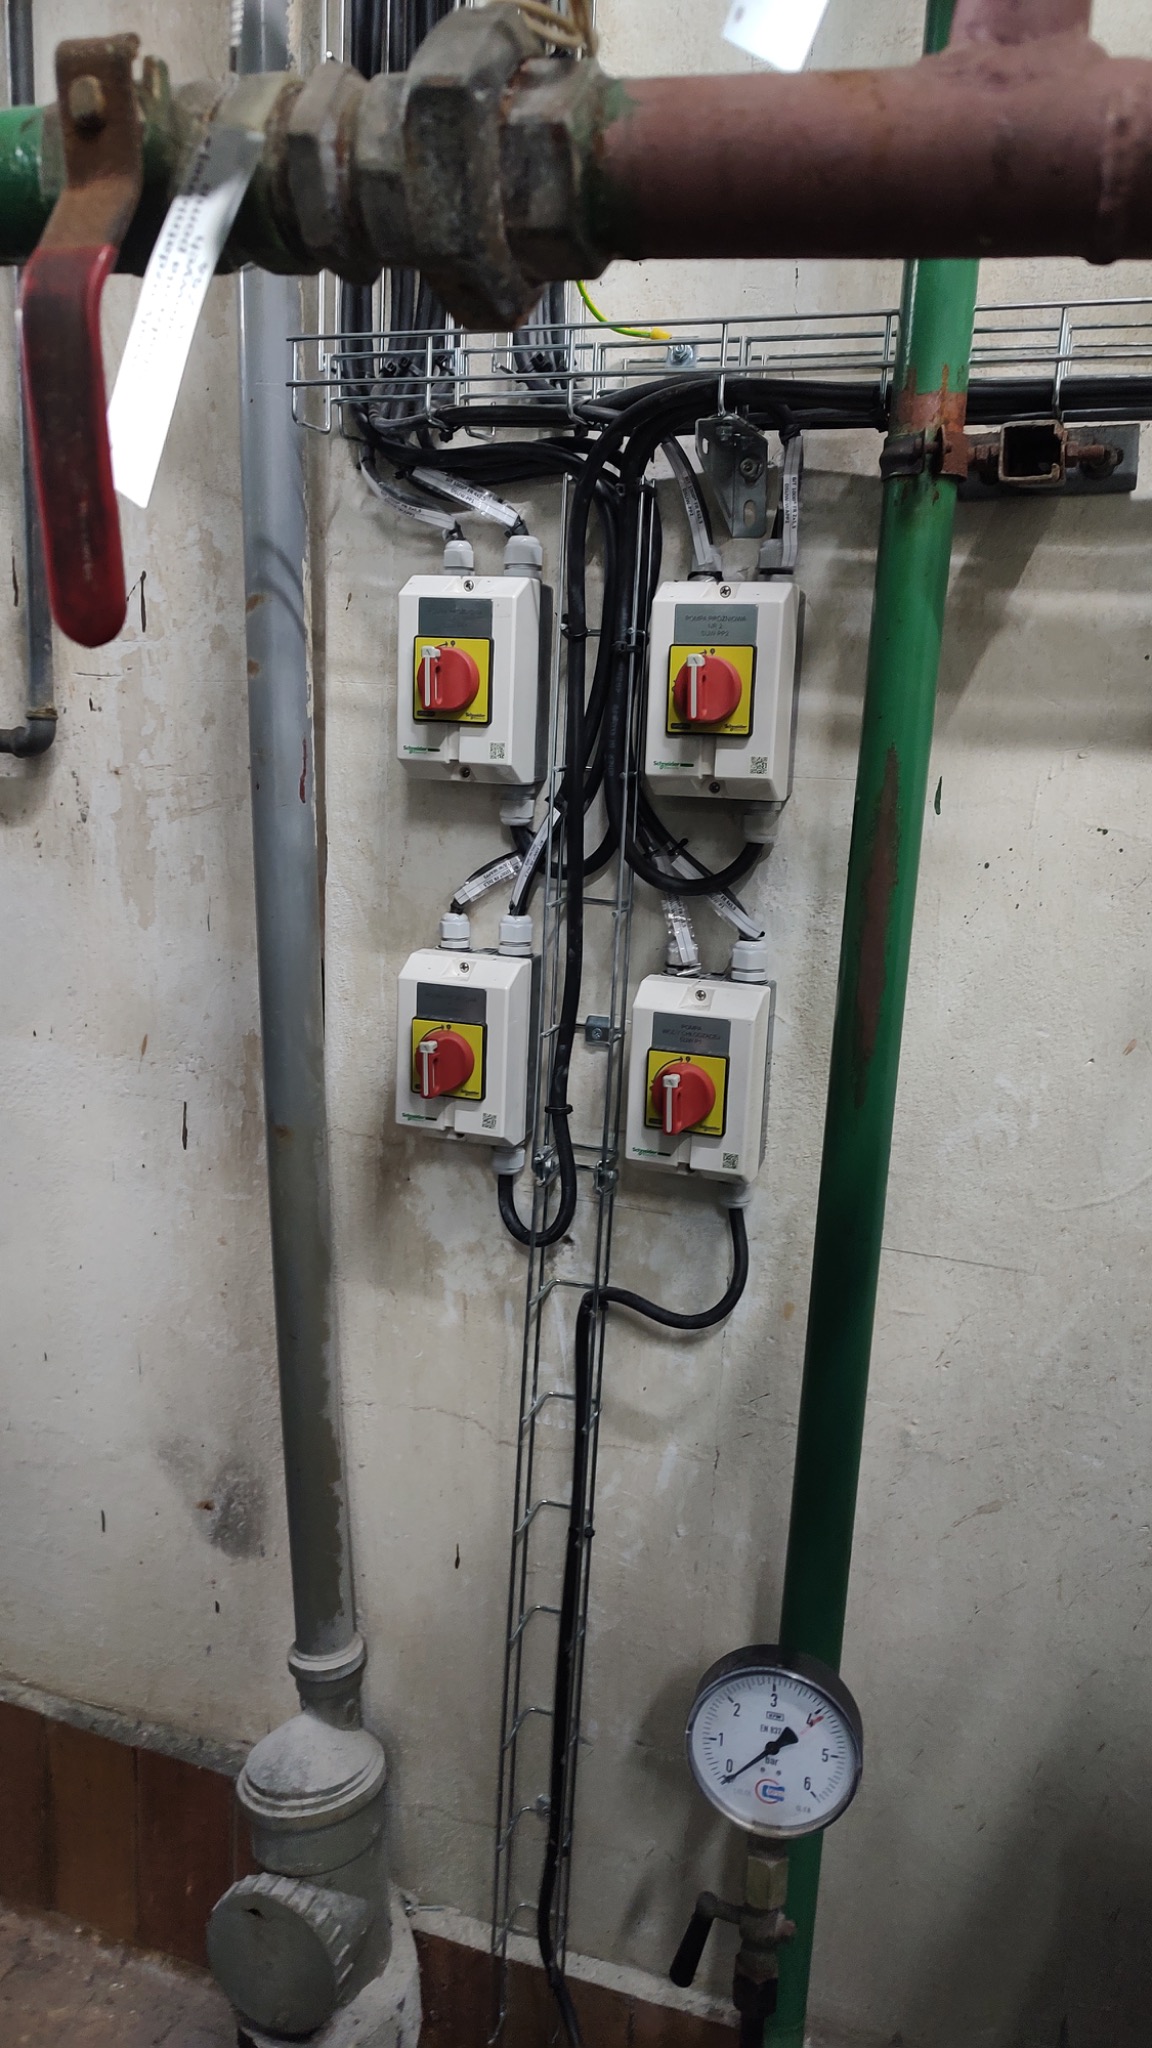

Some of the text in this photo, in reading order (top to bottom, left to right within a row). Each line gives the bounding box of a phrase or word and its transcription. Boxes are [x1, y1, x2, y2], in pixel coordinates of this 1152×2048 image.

[770, 1693, 778, 1708] 3
[733, 1702, 741, 1717] 2
[718, 1732, 724, 1746] 1
[765, 1756, 778, 1766] bar
[822, 1748, 829, 1762] 5
[726, 1758, 733, 1773] 0
[804, 1776, 811, 1790] 6
